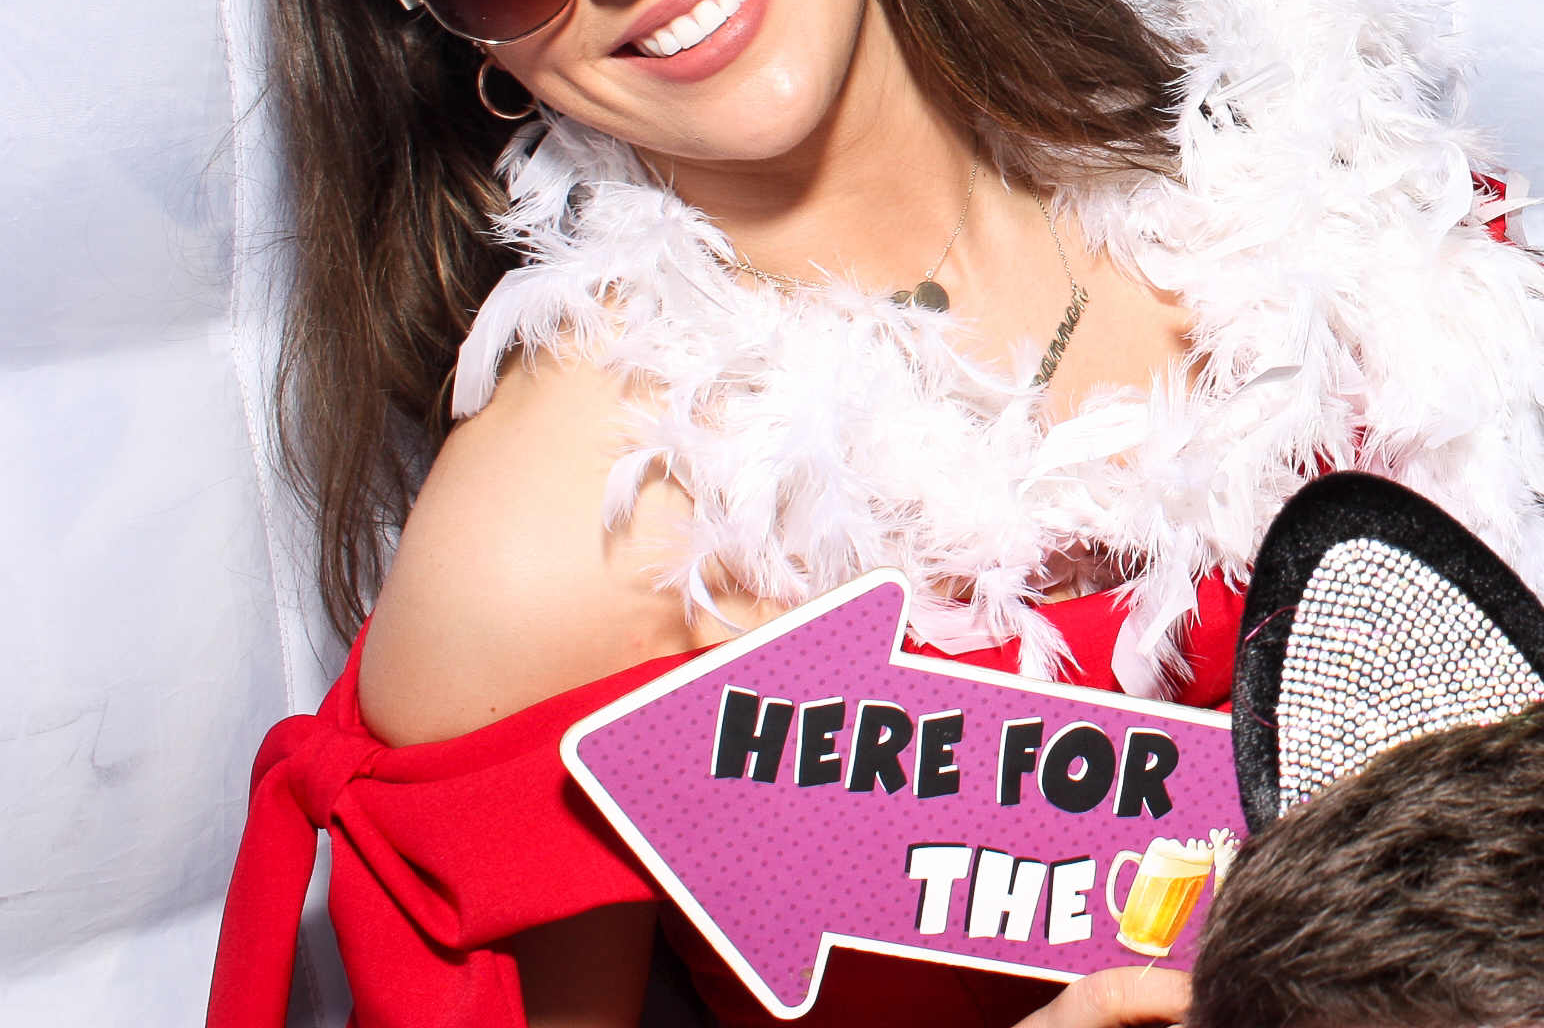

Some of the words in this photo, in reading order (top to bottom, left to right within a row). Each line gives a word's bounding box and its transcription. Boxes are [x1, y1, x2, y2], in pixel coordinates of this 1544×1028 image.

[710, 683, 964, 800] HERE
[996, 716, 1181, 820] FOR
[904, 842, 1097, 946] THE
